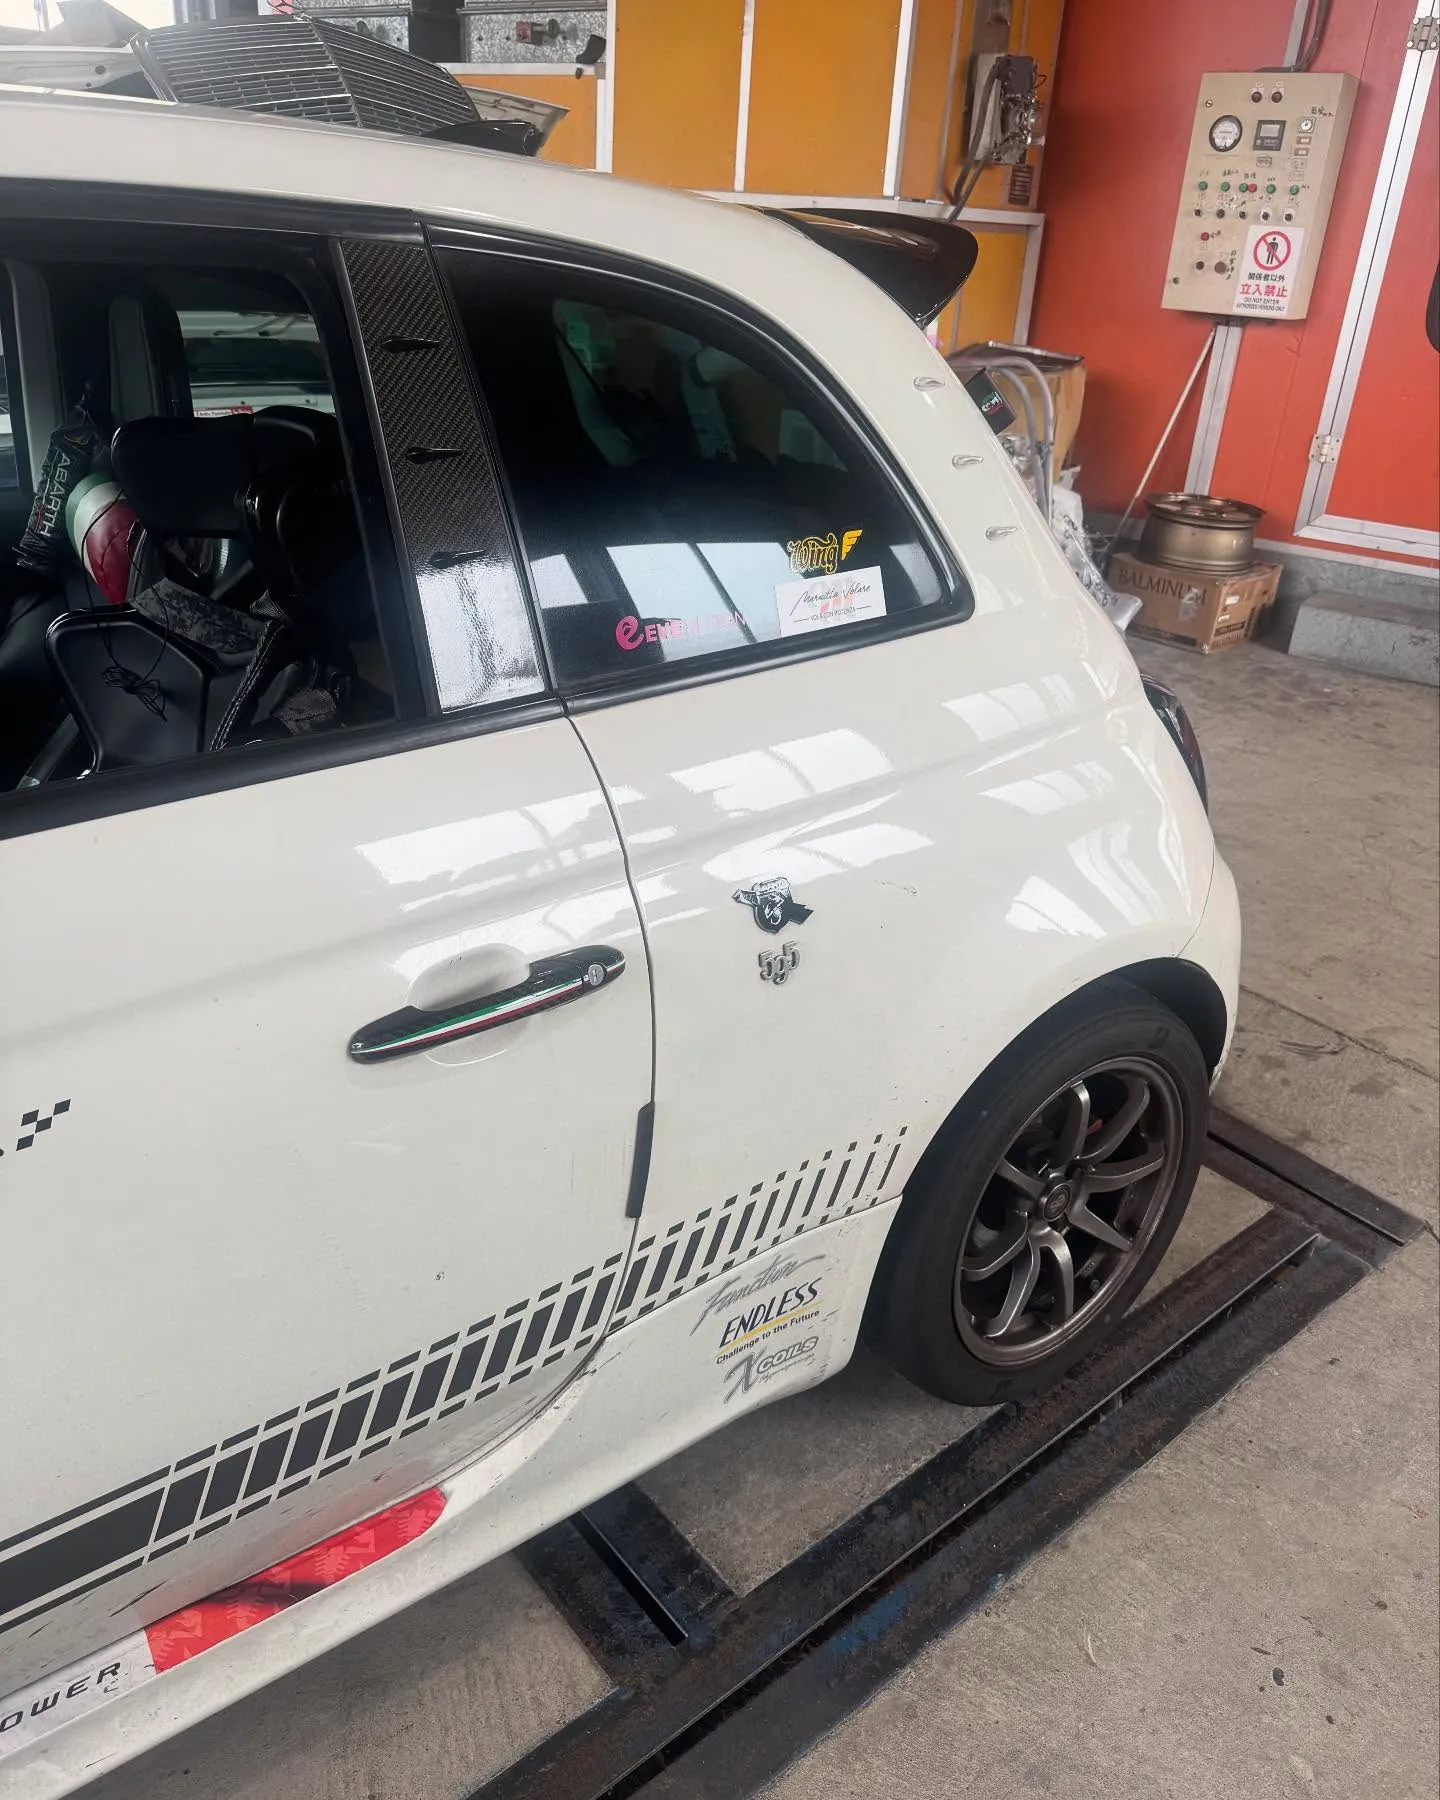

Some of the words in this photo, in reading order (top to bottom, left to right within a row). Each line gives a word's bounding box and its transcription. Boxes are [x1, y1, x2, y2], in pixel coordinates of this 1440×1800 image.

[1239, 283, 1289, 298] 立入禁止
[1248, 272, 1286, 283] 関係者以外
[39, 451, 71, 538] ABARTH
[786, 532, 839, 575] Wing
[716, 1337, 760, 1365] Challenge
[762, 1331, 772, 1342] to
[773, 1322, 788, 1334] the
[789, 1309, 821, 1327] Future
[719, 1276, 823, 1349] ENDLESS
[0, 1661, 122, 1733] OWER
